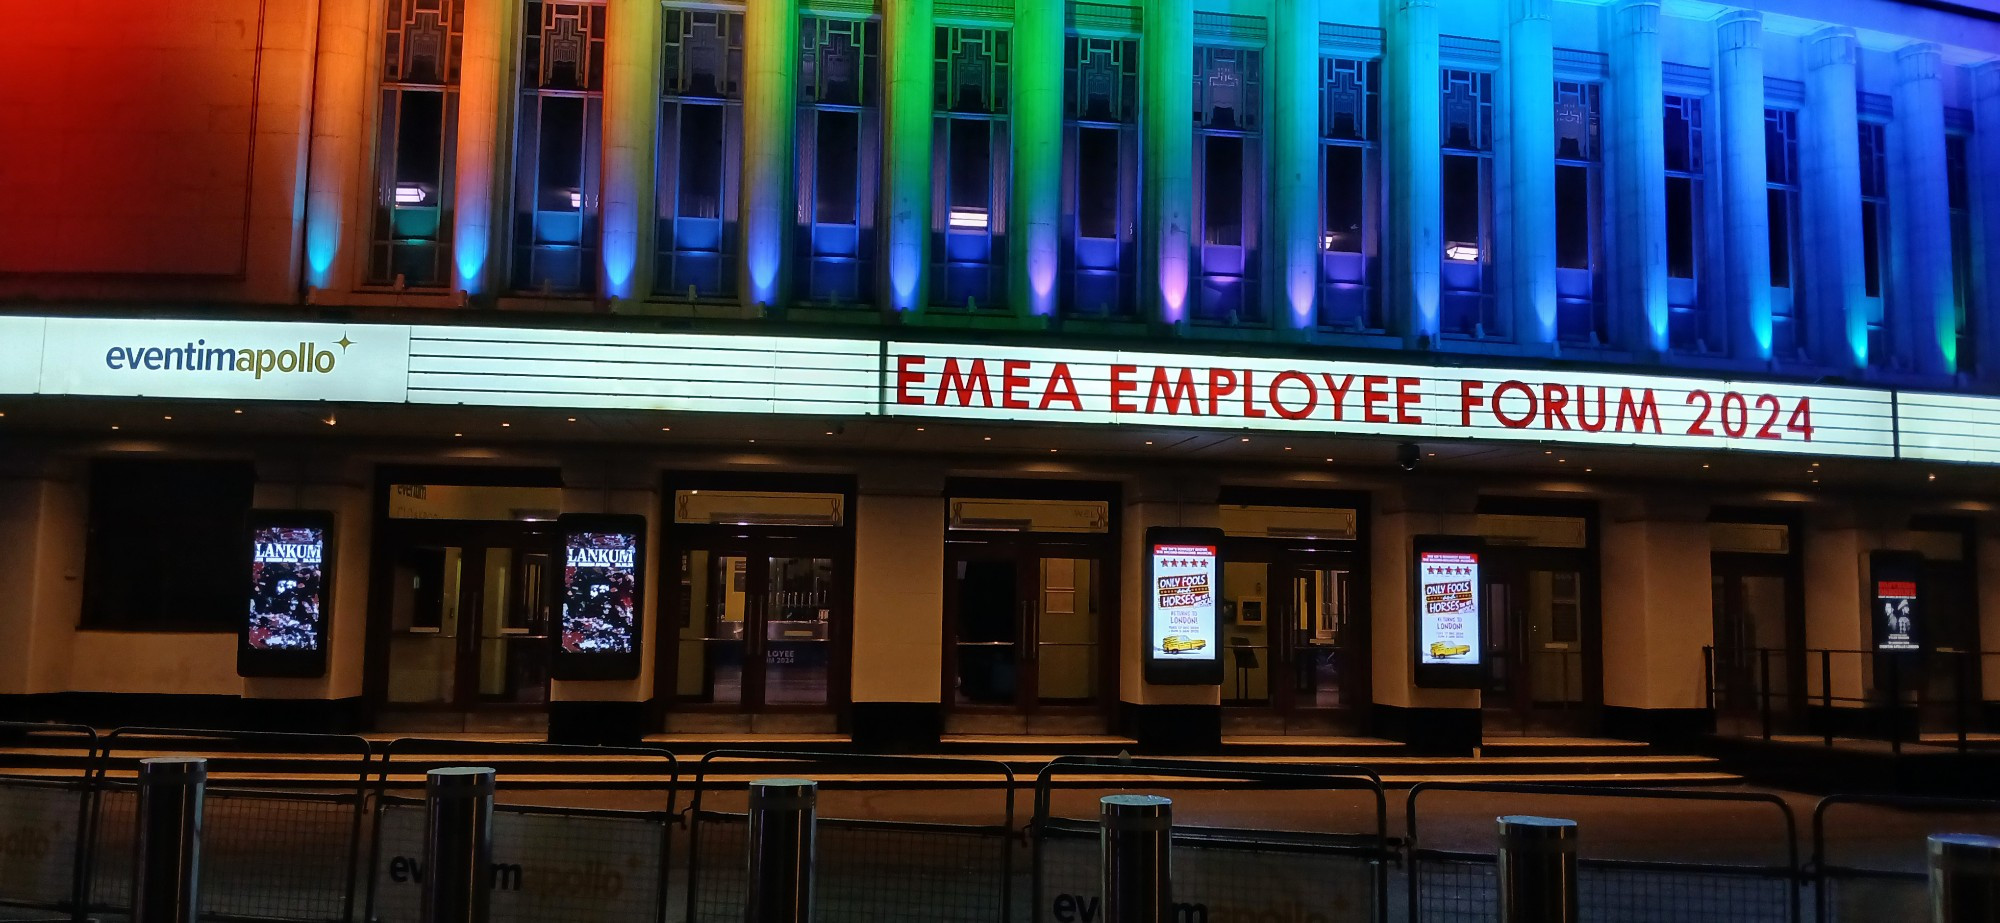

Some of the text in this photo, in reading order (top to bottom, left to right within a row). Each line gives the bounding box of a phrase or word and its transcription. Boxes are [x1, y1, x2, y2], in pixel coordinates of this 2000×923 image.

[106, 339, 335, 379] eventimapollo
[897, 355, 1814, 443] EMEA EMPLOYEE FORUM 2024
[256, 544, 321, 558] LANKUM
[568, 549, 633, 563] LANKUM
[1160, 575, 1206, 588] ONLY FOOLS
[1426, 582, 1469, 595] ONLY FOOLS
[1163, 594, 1196, 607] HORSES
[1430, 601, 1459, 612] HORSES
[1170, 616, 1198, 625] LONDON!
[1437, 622, 1463, 630] LONDON!
